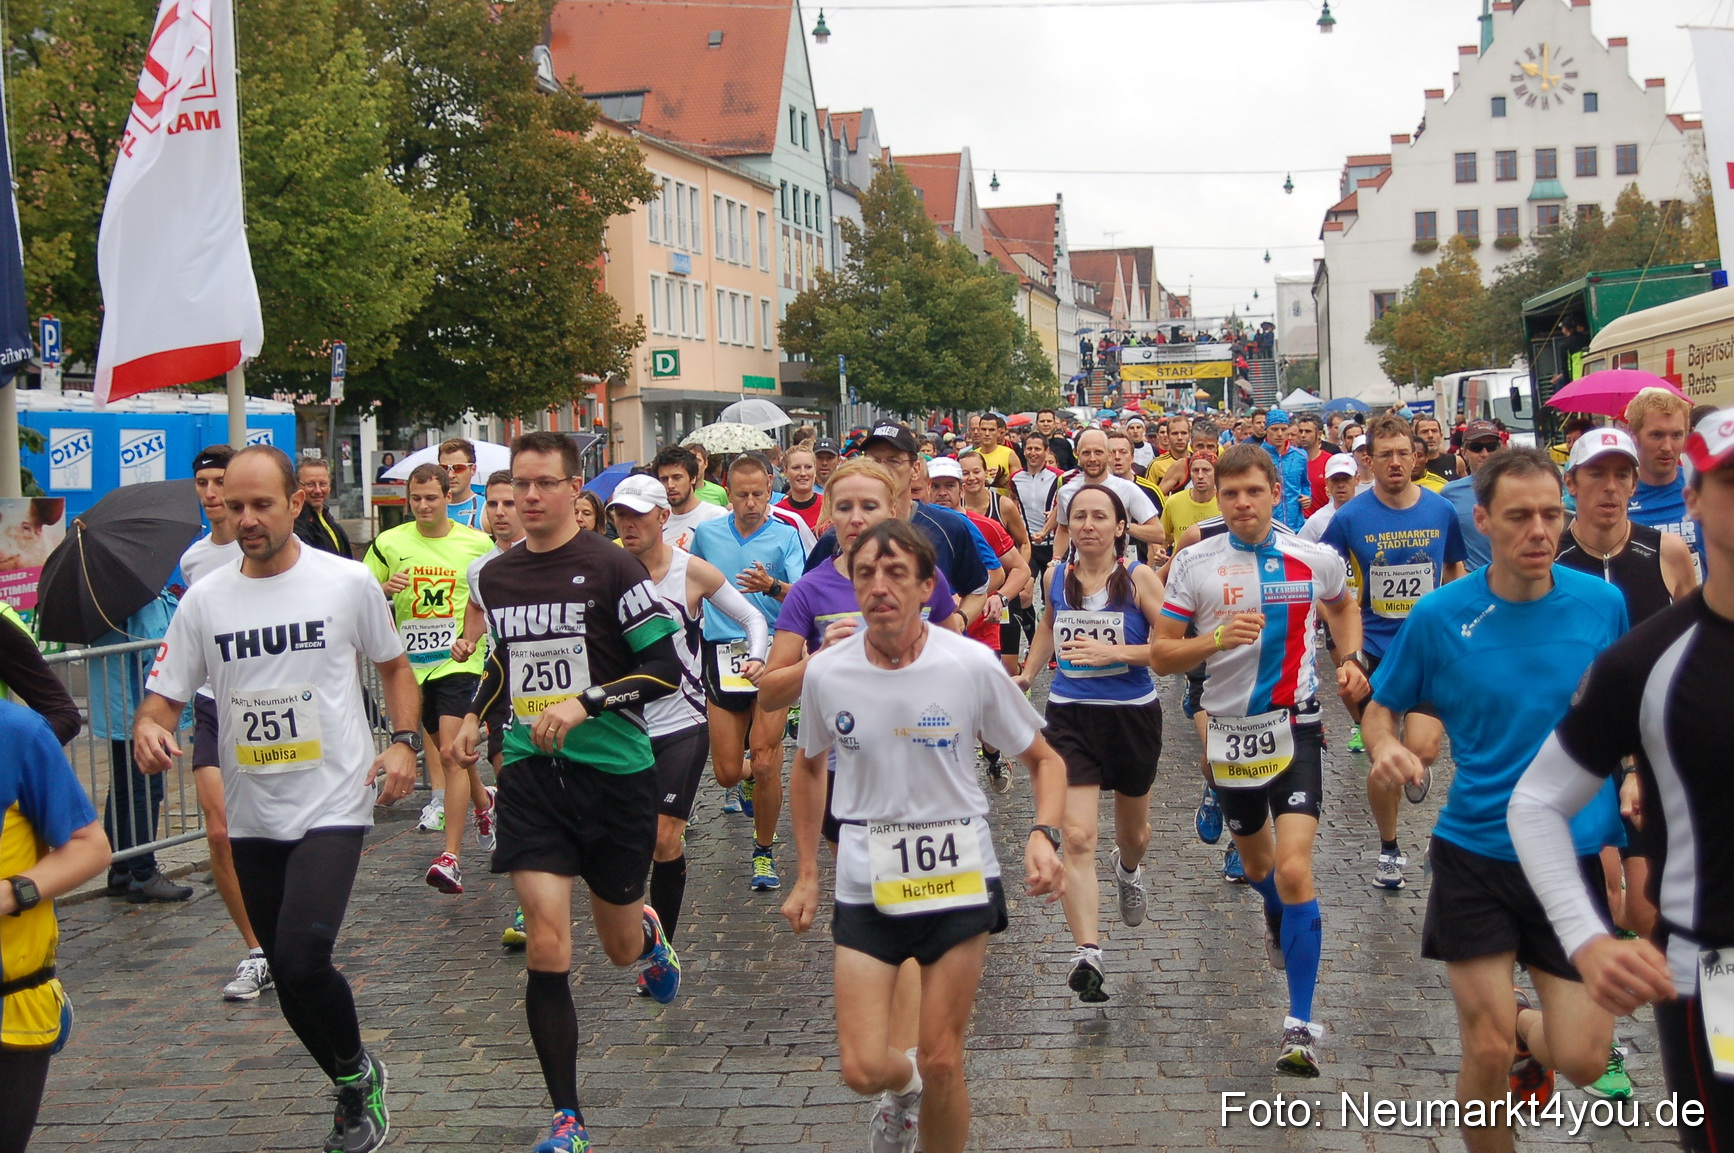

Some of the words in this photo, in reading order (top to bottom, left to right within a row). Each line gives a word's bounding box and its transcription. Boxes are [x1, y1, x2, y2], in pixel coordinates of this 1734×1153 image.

[45, 324, 57, 358] P
[335, 349, 343, 374] P
[656, 353, 676, 373] D
[1157, 366, 1195, 377] START
[1688, 372, 1717, 396] Rotes
[1364, 534, 1377, 543] 10.
[1378, 529, 1441, 541] NEUMARKTER
[1377, 539, 1430, 551] STADTLAUF
[413, 565, 457, 577] Müller
[1392, 569, 1422, 577] Neumarkt
[1383, 577, 1421, 598] 242
[491, 603, 586, 638] THULE
[214, 620, 325, 662] THULE
[294, 641, 322, 650] SWEDEN
[406, 630, 452, 652] 2532
[529, 648, 570, 658] Neumarkt
[522, 659, 571, 692] 250
[231, 697, 252, 708] PARTL
[254, 694, 299, 707] Neumarkt
[243, 707, 298, 742] 251
[1209, 723, 1235, 731] PARTL
[1237, 719, 1277, 732] Neumarkt
[1225, 730, 1276, 761] 399
[254, 747, 297, 764] Ljubisa
[1228, 762, 1279, 778] Benjamin
[870, 823, 905, 836] PARTL
[907, 818, 957, 832] Neumarkt
[892, 832, 960, 874] 164
[902, 879, 956, 898] Herbert
